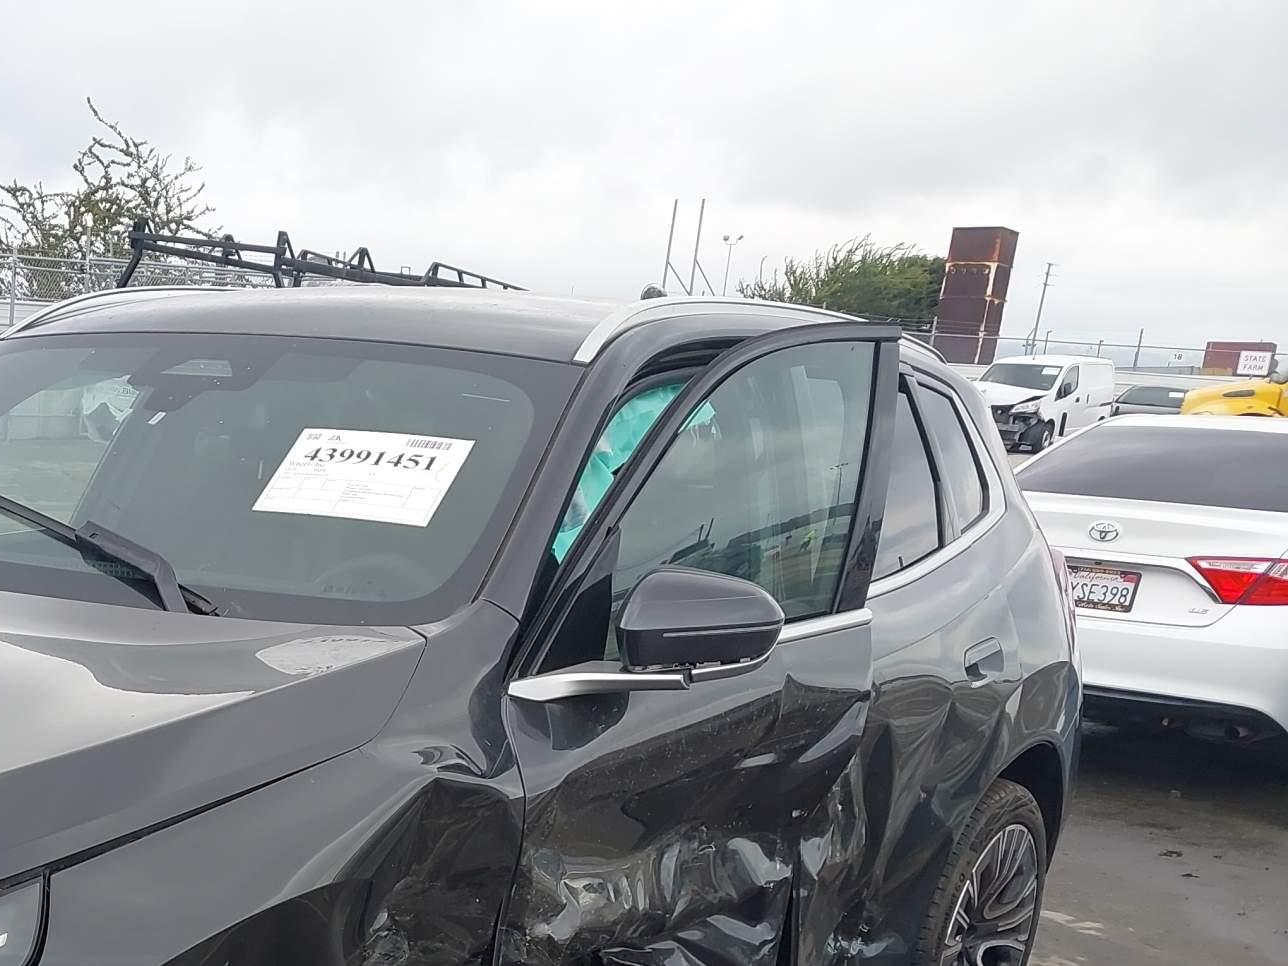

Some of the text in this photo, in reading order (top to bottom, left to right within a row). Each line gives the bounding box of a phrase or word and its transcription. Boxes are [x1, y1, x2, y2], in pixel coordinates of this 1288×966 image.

[1173, 352, 1183, 361] 18
[1244, 355, 1267, 363] STATE
[1242, 363, 1264, 371] FARM
[303, 445, 439, 472] 43991451
